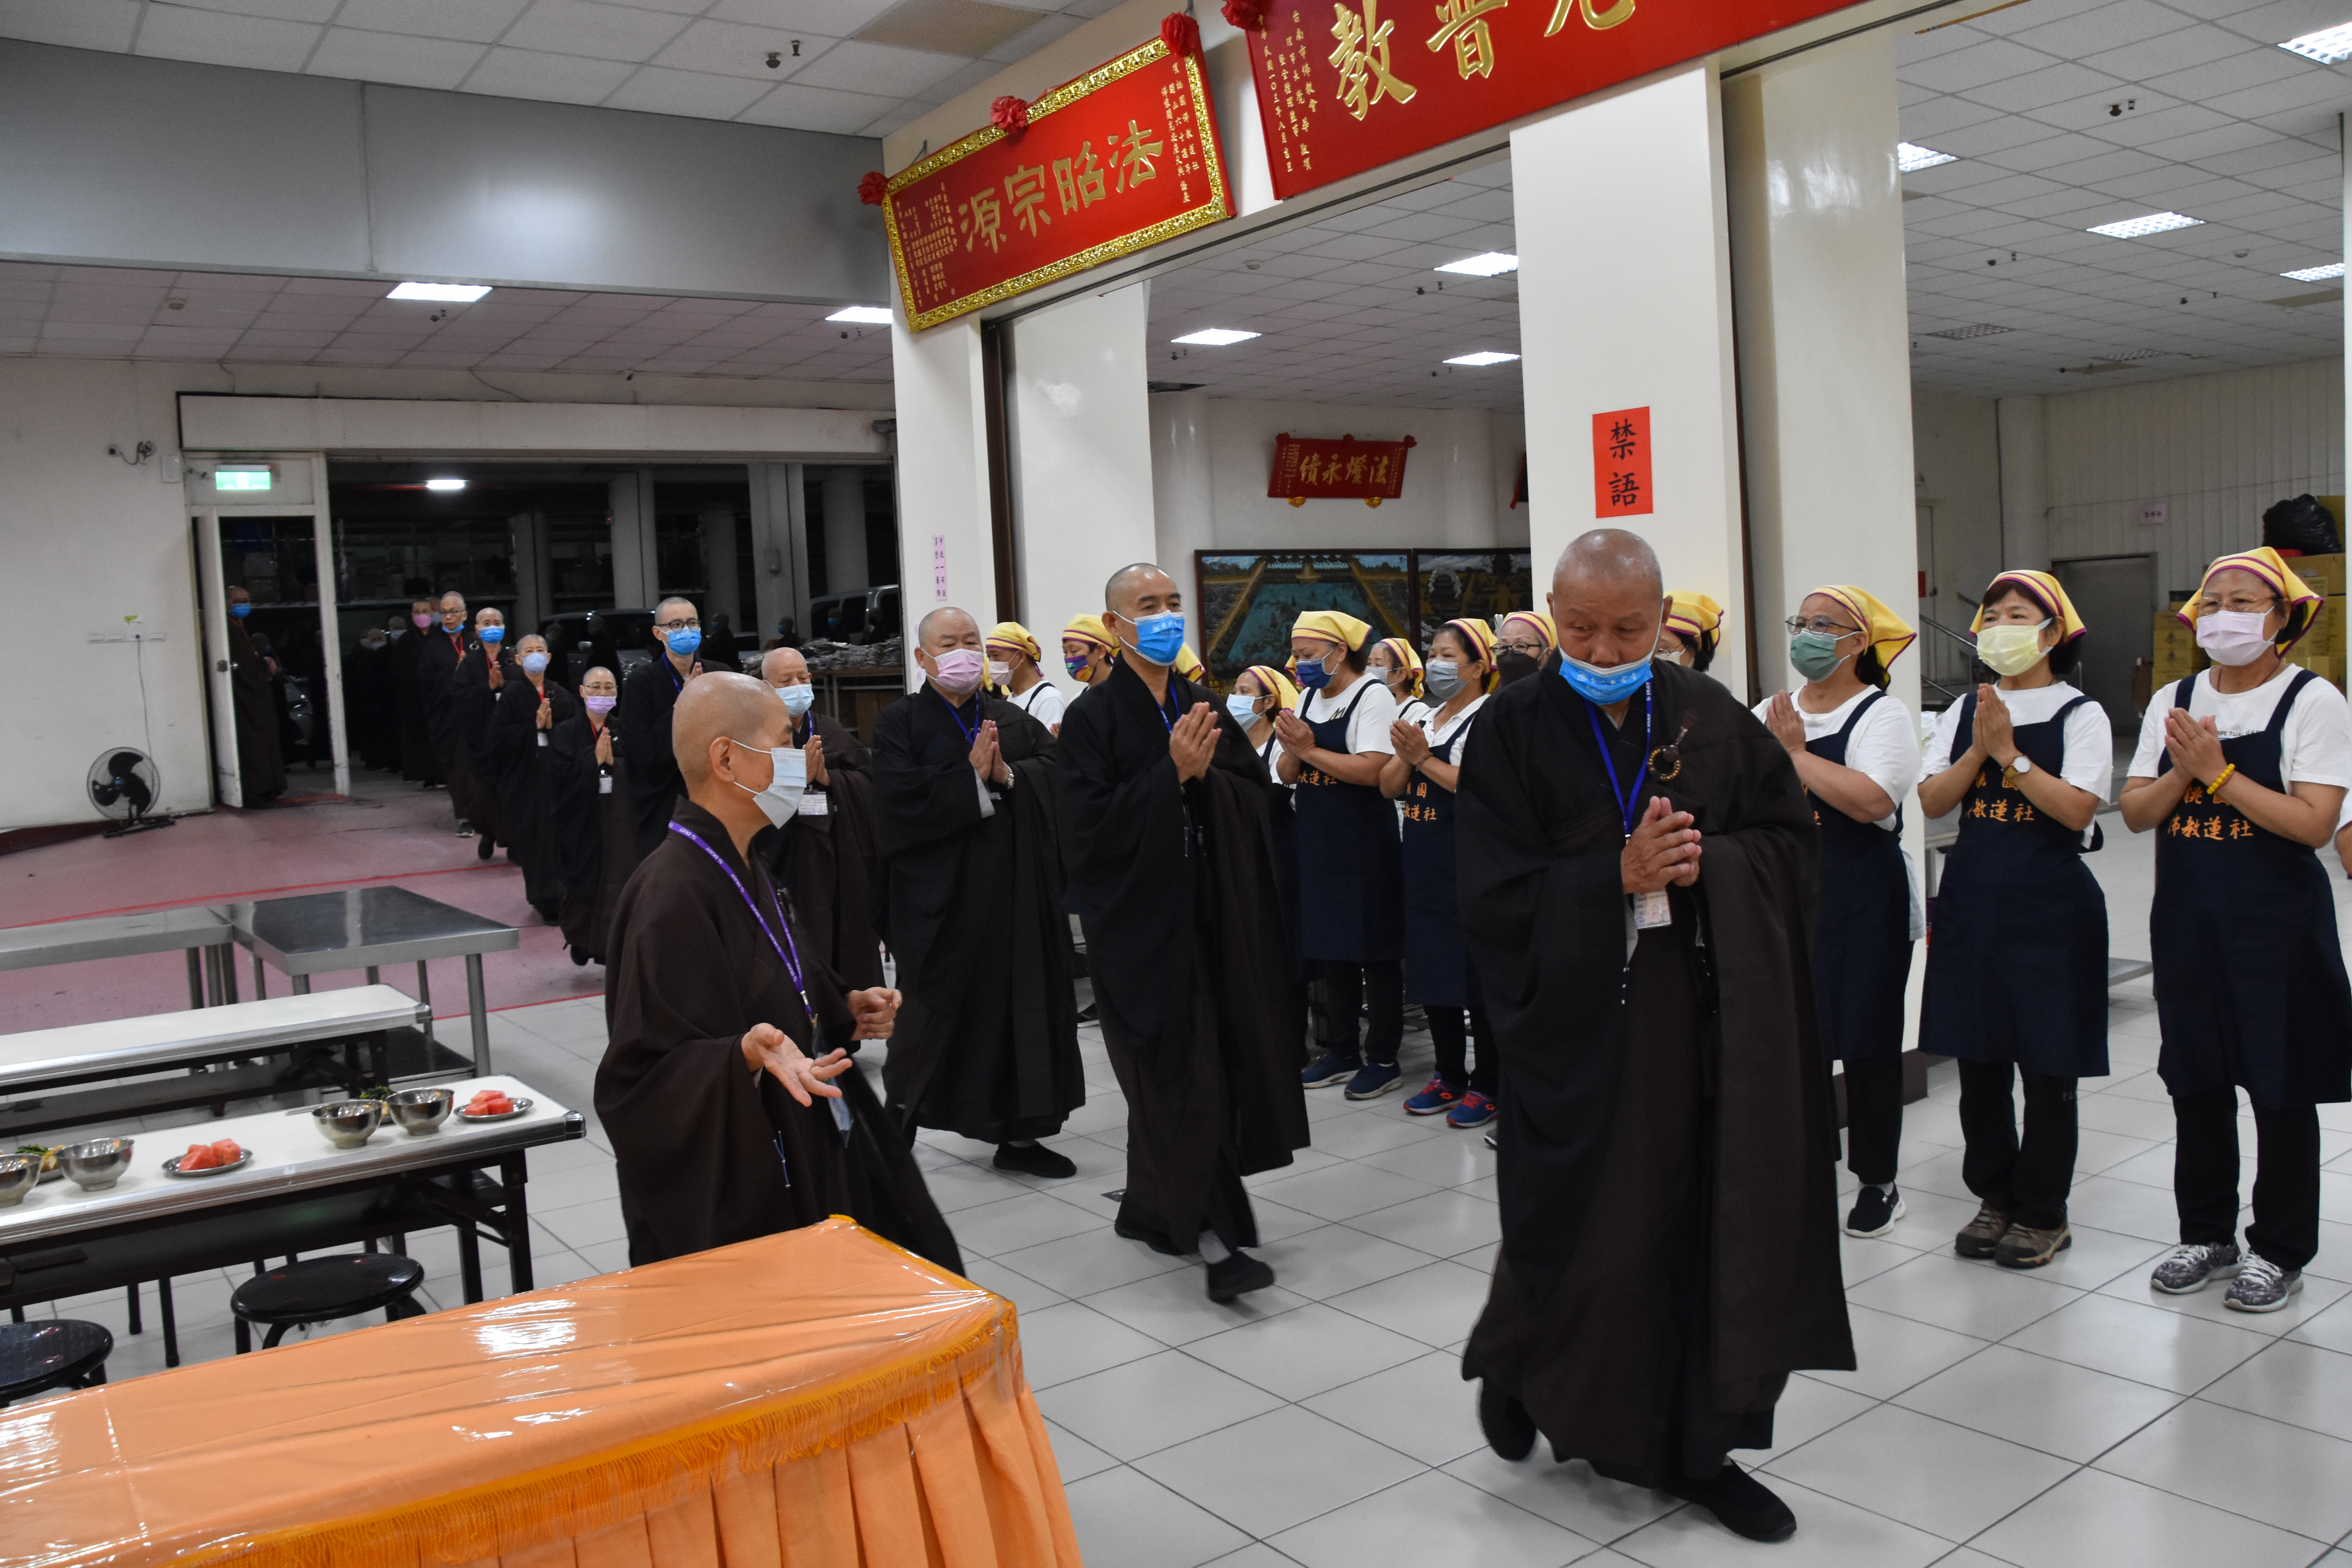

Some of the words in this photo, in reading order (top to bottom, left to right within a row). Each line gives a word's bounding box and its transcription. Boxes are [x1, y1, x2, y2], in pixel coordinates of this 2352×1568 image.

[958, 119, 1163, 253] 法昭宗源
[1608, 419, 1640, 506] 禁語
